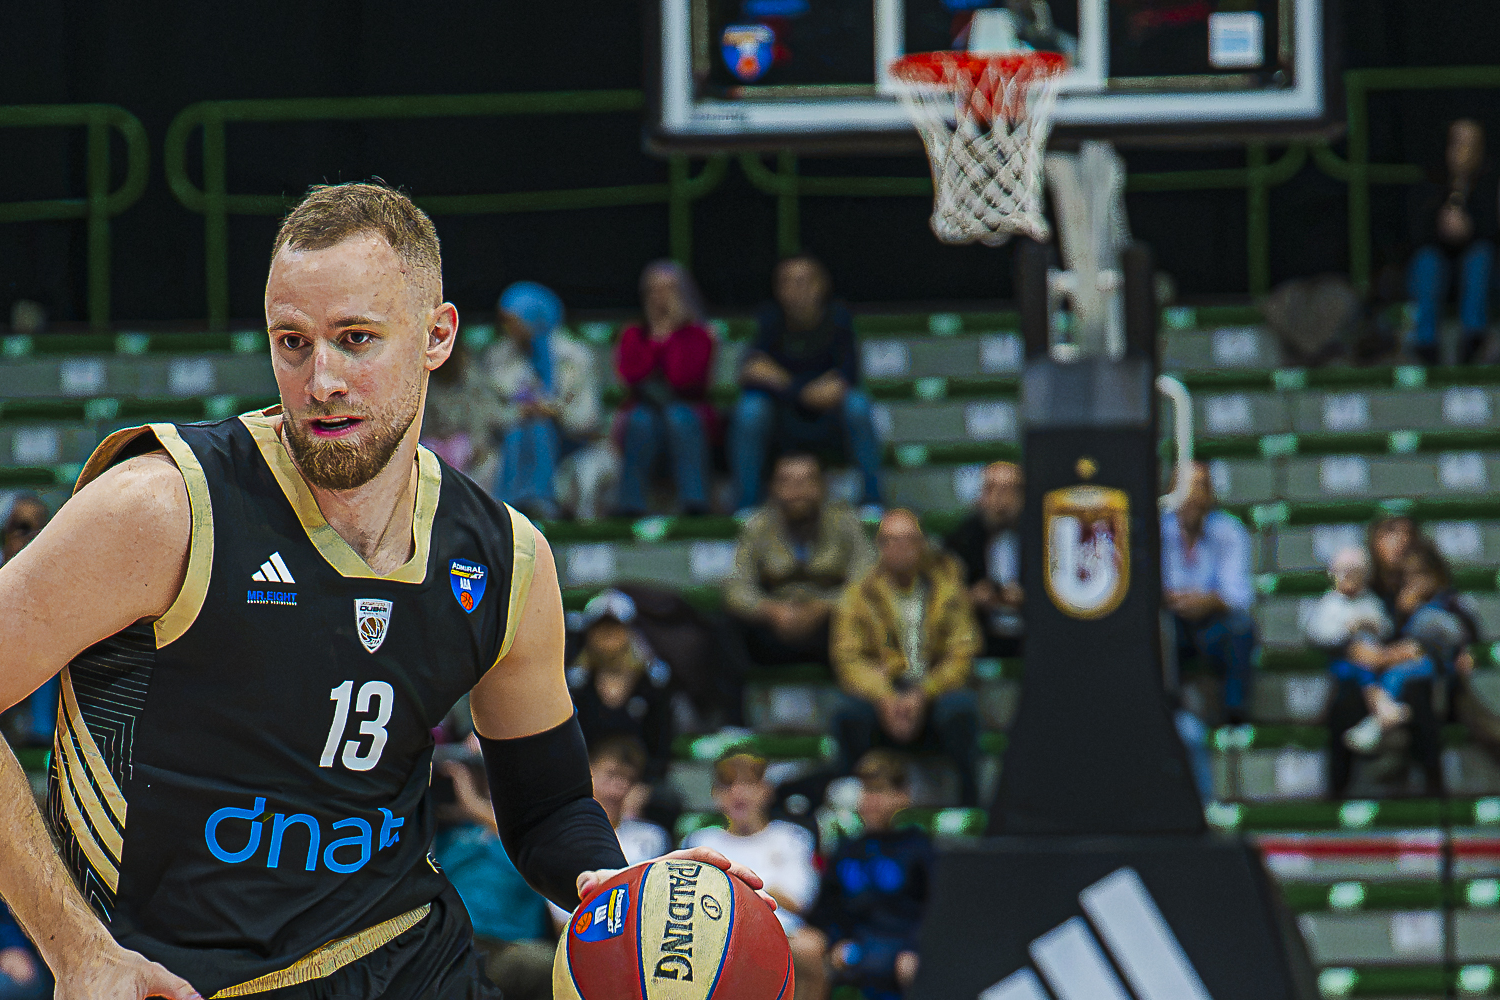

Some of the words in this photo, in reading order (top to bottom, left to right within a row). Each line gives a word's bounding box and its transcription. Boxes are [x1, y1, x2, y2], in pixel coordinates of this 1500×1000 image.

[452, 562, 484, 574] ADMIRAL
[247, 590, 298, 603] MR.EIGHT
[318, 679, 394, 771] 13
[204, 796, 405, 874] dnat
